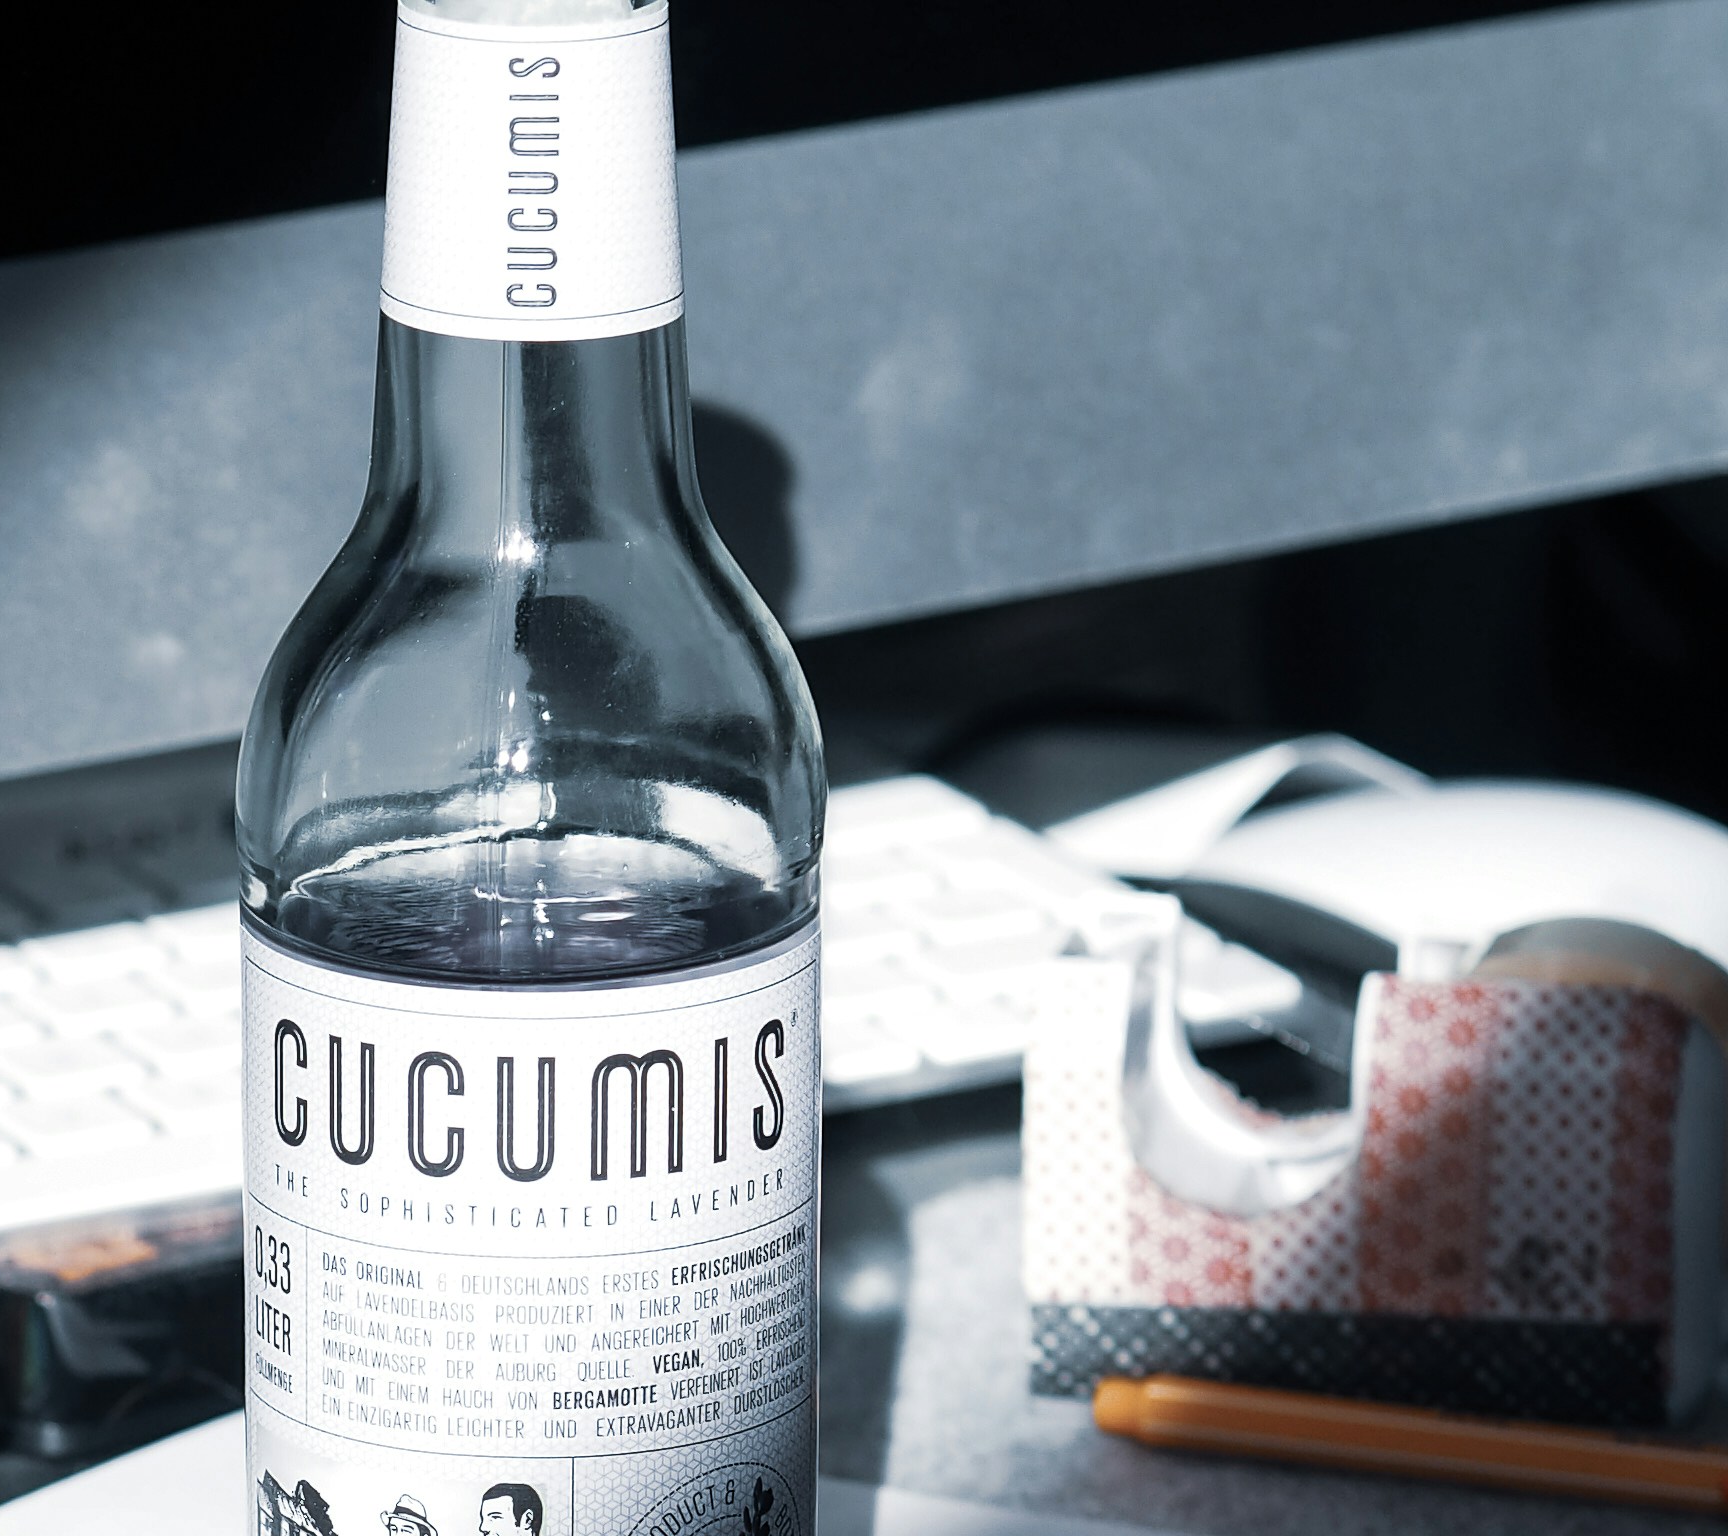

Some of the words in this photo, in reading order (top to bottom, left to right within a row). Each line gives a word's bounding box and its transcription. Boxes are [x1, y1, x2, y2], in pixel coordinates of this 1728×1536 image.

[506, 57, 561, 307] CUCUMIS
[274, 1019, 785, 1181] CUCUMIS
[274, 1163, 309, 1198] THE
[340, 1187, 618, 1228] SOPHISTICATED
[651, 1167, 784, 1223] LAVENDER
[255, 1225, 291, 1294] 0,33
[322, 1252, 347, 1276] DAS
[356, 1261, 424, 1290] ORIGINAL
[461, 1274, 590, 1296] DEUTSCHLANDS
[603, 1270, 659, 1293] ERSTES
[255, 1294, 291, 1356] LITER
[322, 1281, 344, 1302] AUF
[357, 1291, 475, 1323] LAVENDELBASIS
[495, 1304, 594, 1325] PRODUZIERT
[610, 1302, 624, 1322] IN
[639, 1296, 681, 1320] EINER
[694, 1287, 719, 1311] DER
[322, 1338, 426, 1376] MINERALWASSER
[446, 1359, 474, 1380] DER
[495, 1362, 556, 1382] AUBURG
[717, 1336, 747, 1362] 100%
[446, 1331, 476, 1351] DER
[490, 1333, 530, 1353] WELT
[544, 1334, 577, 1353] UND
[591, 1320, 700, 1352] ANGEREICHERT
[710, 1312, 731, 1337] MIT
[322, 1366, 345, 1389] UND
[355, 1374, 375, 1397] MIT
[388, 1381, 429, 1405] EINEM
[442, 1387, 493, 1409] HAUCH
[507, 1391, 538, 1411] VON
[553, 1384, 658, 1410] BERGAMOTTE
[671, 1366, 740, 1401] VERFEINERT
[749, 1358, 763, 1382] IST
[322, 1393, 340, 1416] EIN
[348, 1401, 437, 1434] EINZIGARTIG
[447, 1416, 525, 1439] LEICHTER
[544, 1419, 577, 1439] UND
[596, 1401, 721, 1437] EXTRAVAGANTER
